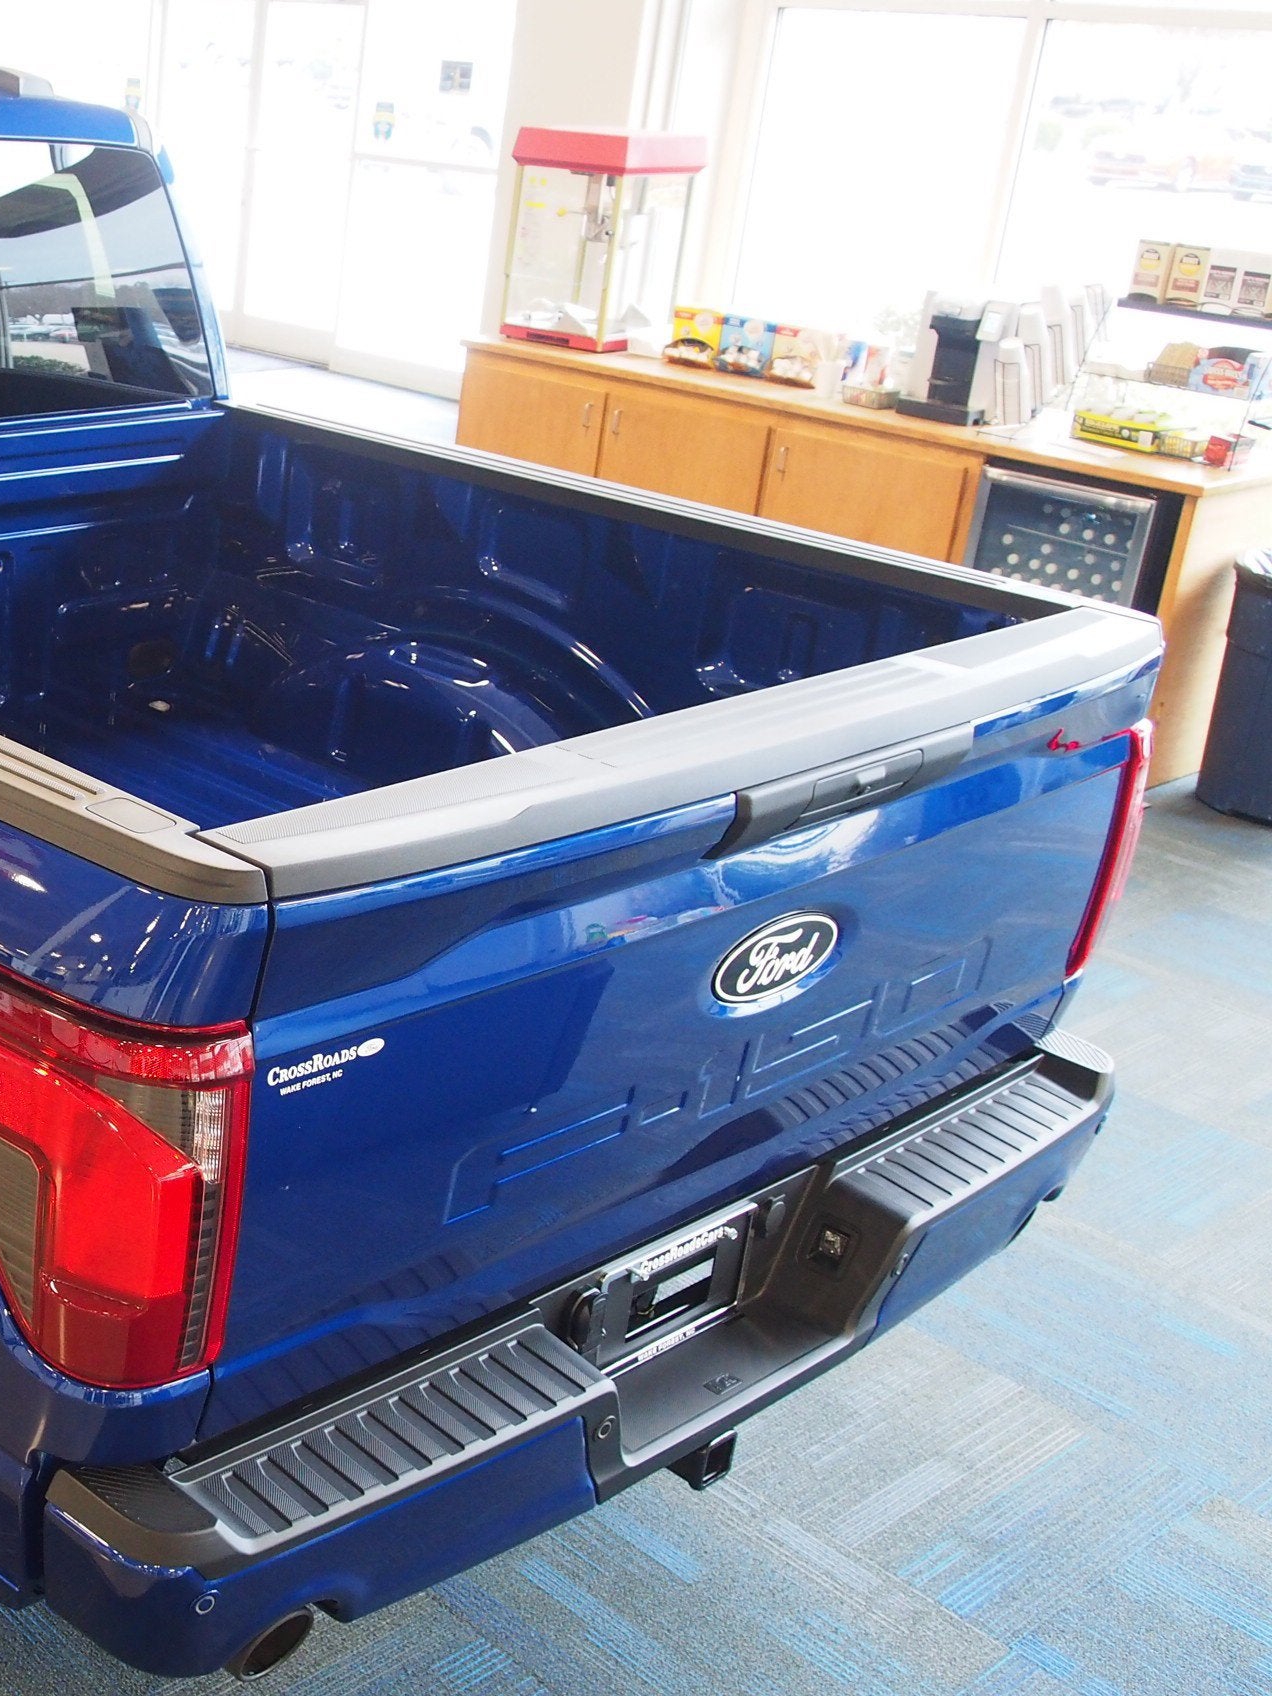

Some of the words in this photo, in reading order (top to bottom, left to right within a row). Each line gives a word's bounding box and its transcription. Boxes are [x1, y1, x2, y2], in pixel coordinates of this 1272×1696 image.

[736, 928, 820, 994] Ford
[279, 1082, 302, 1096] WAKE
[302, 1072, 332, 1091] FOREST,
[332, 1069, 344, 1080] NC
[443, 937, 992, 1226] F-150
